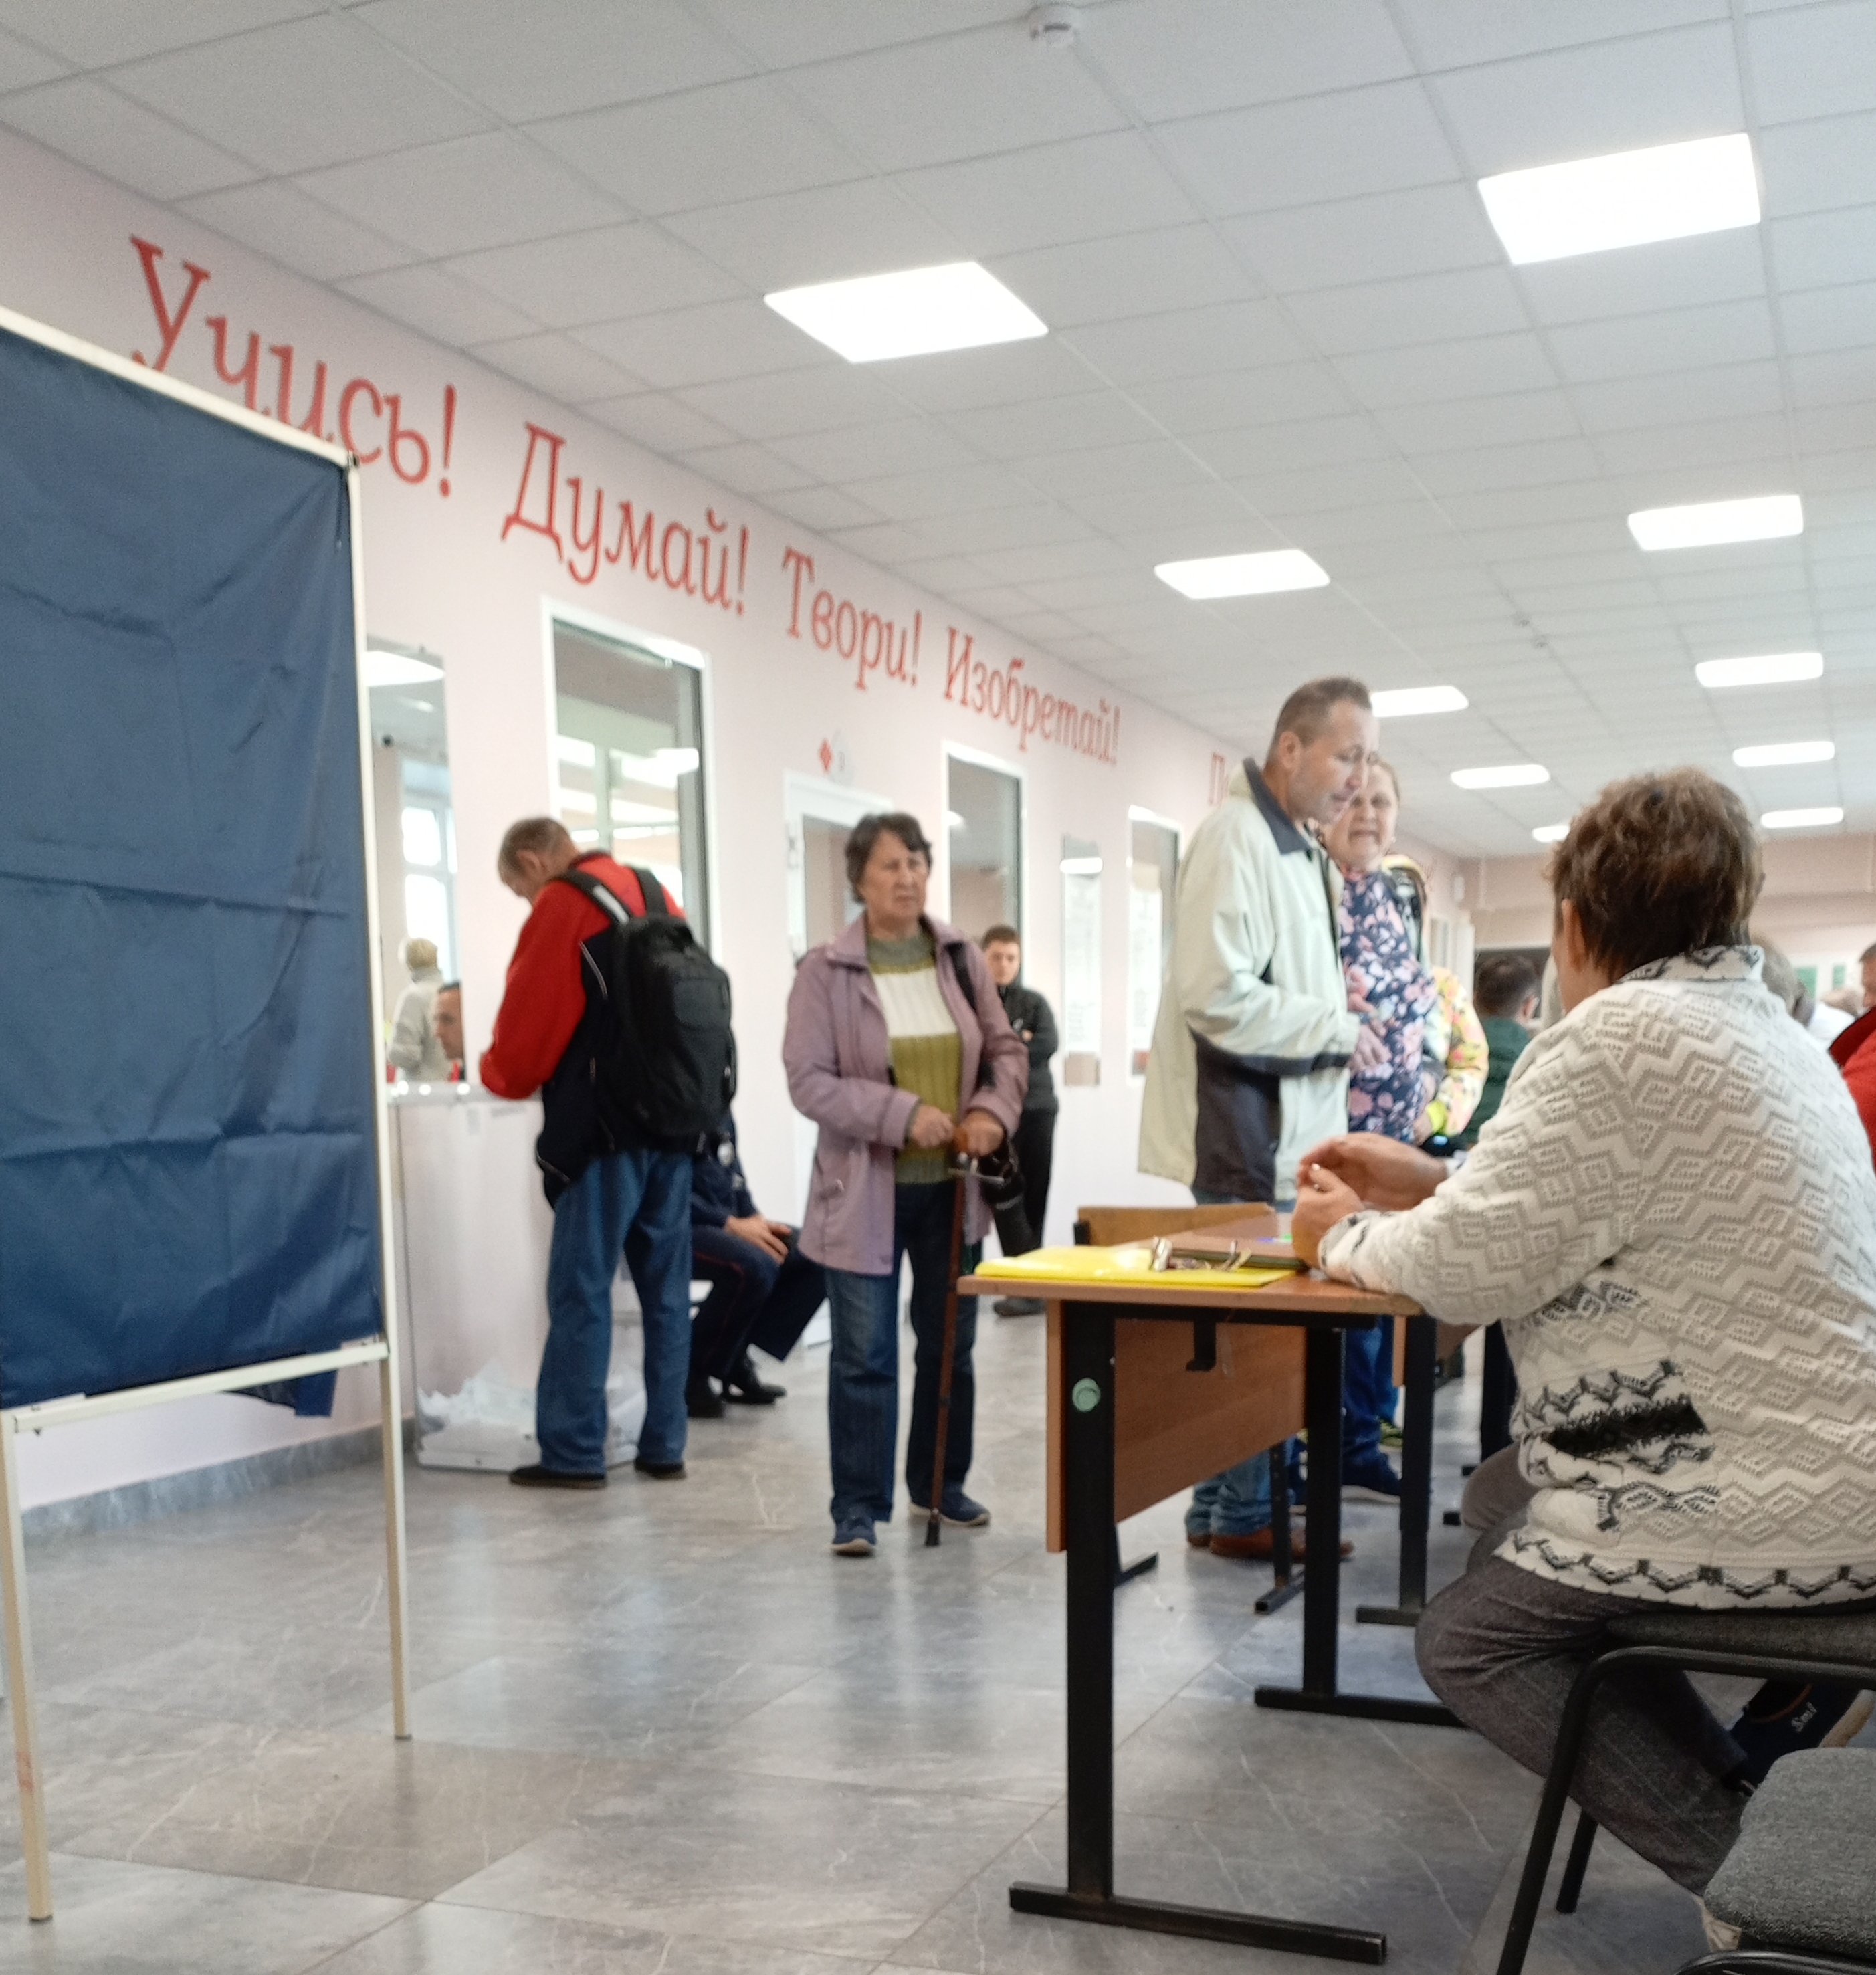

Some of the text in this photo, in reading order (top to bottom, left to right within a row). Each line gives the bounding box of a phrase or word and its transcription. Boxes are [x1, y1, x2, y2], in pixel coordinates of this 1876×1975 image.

[130, 234, 458, 499] Учись!
[500, 421, 750, 617] Думай!
[782, 546, 923, 692] Твори!
[943, 626, 1121, 765] Изобретай!
